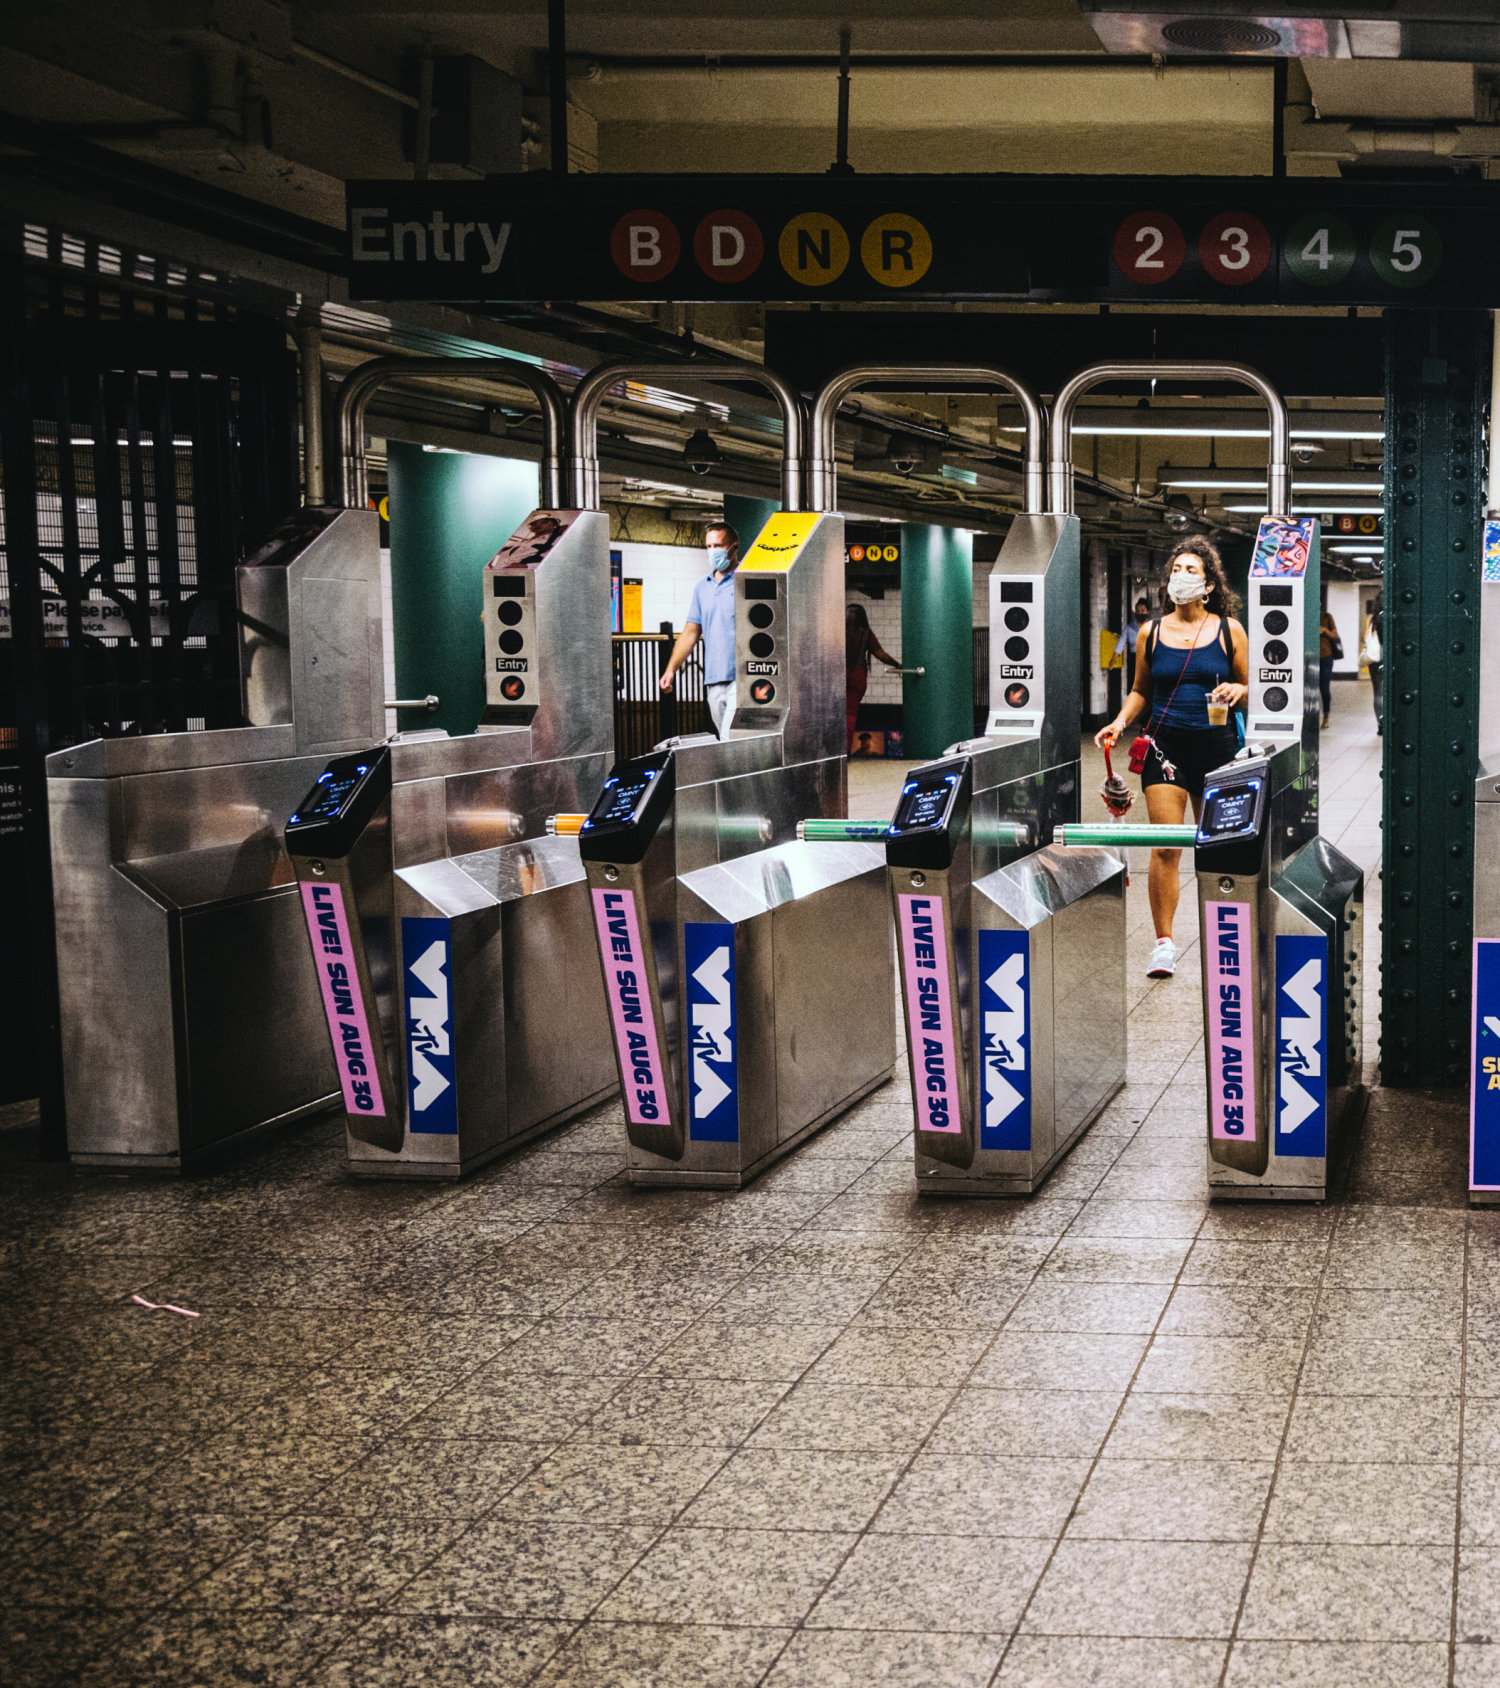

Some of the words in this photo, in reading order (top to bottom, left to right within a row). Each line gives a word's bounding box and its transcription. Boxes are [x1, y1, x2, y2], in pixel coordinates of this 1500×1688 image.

[351, 207, 512, 273] Entry
[629, 226, 663, 267] B
[711, 225, 745, 267] D
[796, 229, 832, 270] N
[881, 229, 914, 271] R
[1135, 226, 1164, 269] 2
[1219, 226, 1251, 270] 3
[1301, 229, 1334, 270] 4
[1390, 230, 1422, 272] 5
[497, 659, 527, 672] Entry
[747, 662, 778, 675] Entry
[1002, 666, 1033, 679] Entry
[1260, 669, 1292, 682] Entry
[618, 789, 640, 798] OMNY
[918, 795, 941, 803] OMNY
[1221, 799, 1245, 808] OMNY
[312, 887, 343, 955] LIVE!
[603, 893, 633, 962] LIVE!
[911, 900, 936, 969] LIVE!
[1217, 906, 1240, 976] LIVE!
[327, 963, 355, 1015] SUN
[617, 971, 643, 1023] SUN
[918, 978, 941, 1030] SUN
[1220, 985, 1241, 1037] SUN
[339, 1022, 367, 1076] AUG
[627, 1031, 653, 1084] AUG
[923, 1038, 946, 1092] AUG
[1222, 1045, 1243, 1100] AUG
[352, 1080, 374, 1110] 30
[637, 1089, 658, 1119] 30
[928, 1097, 949, 1127] 30
[1224, 1105, 1244, 1135] 30
